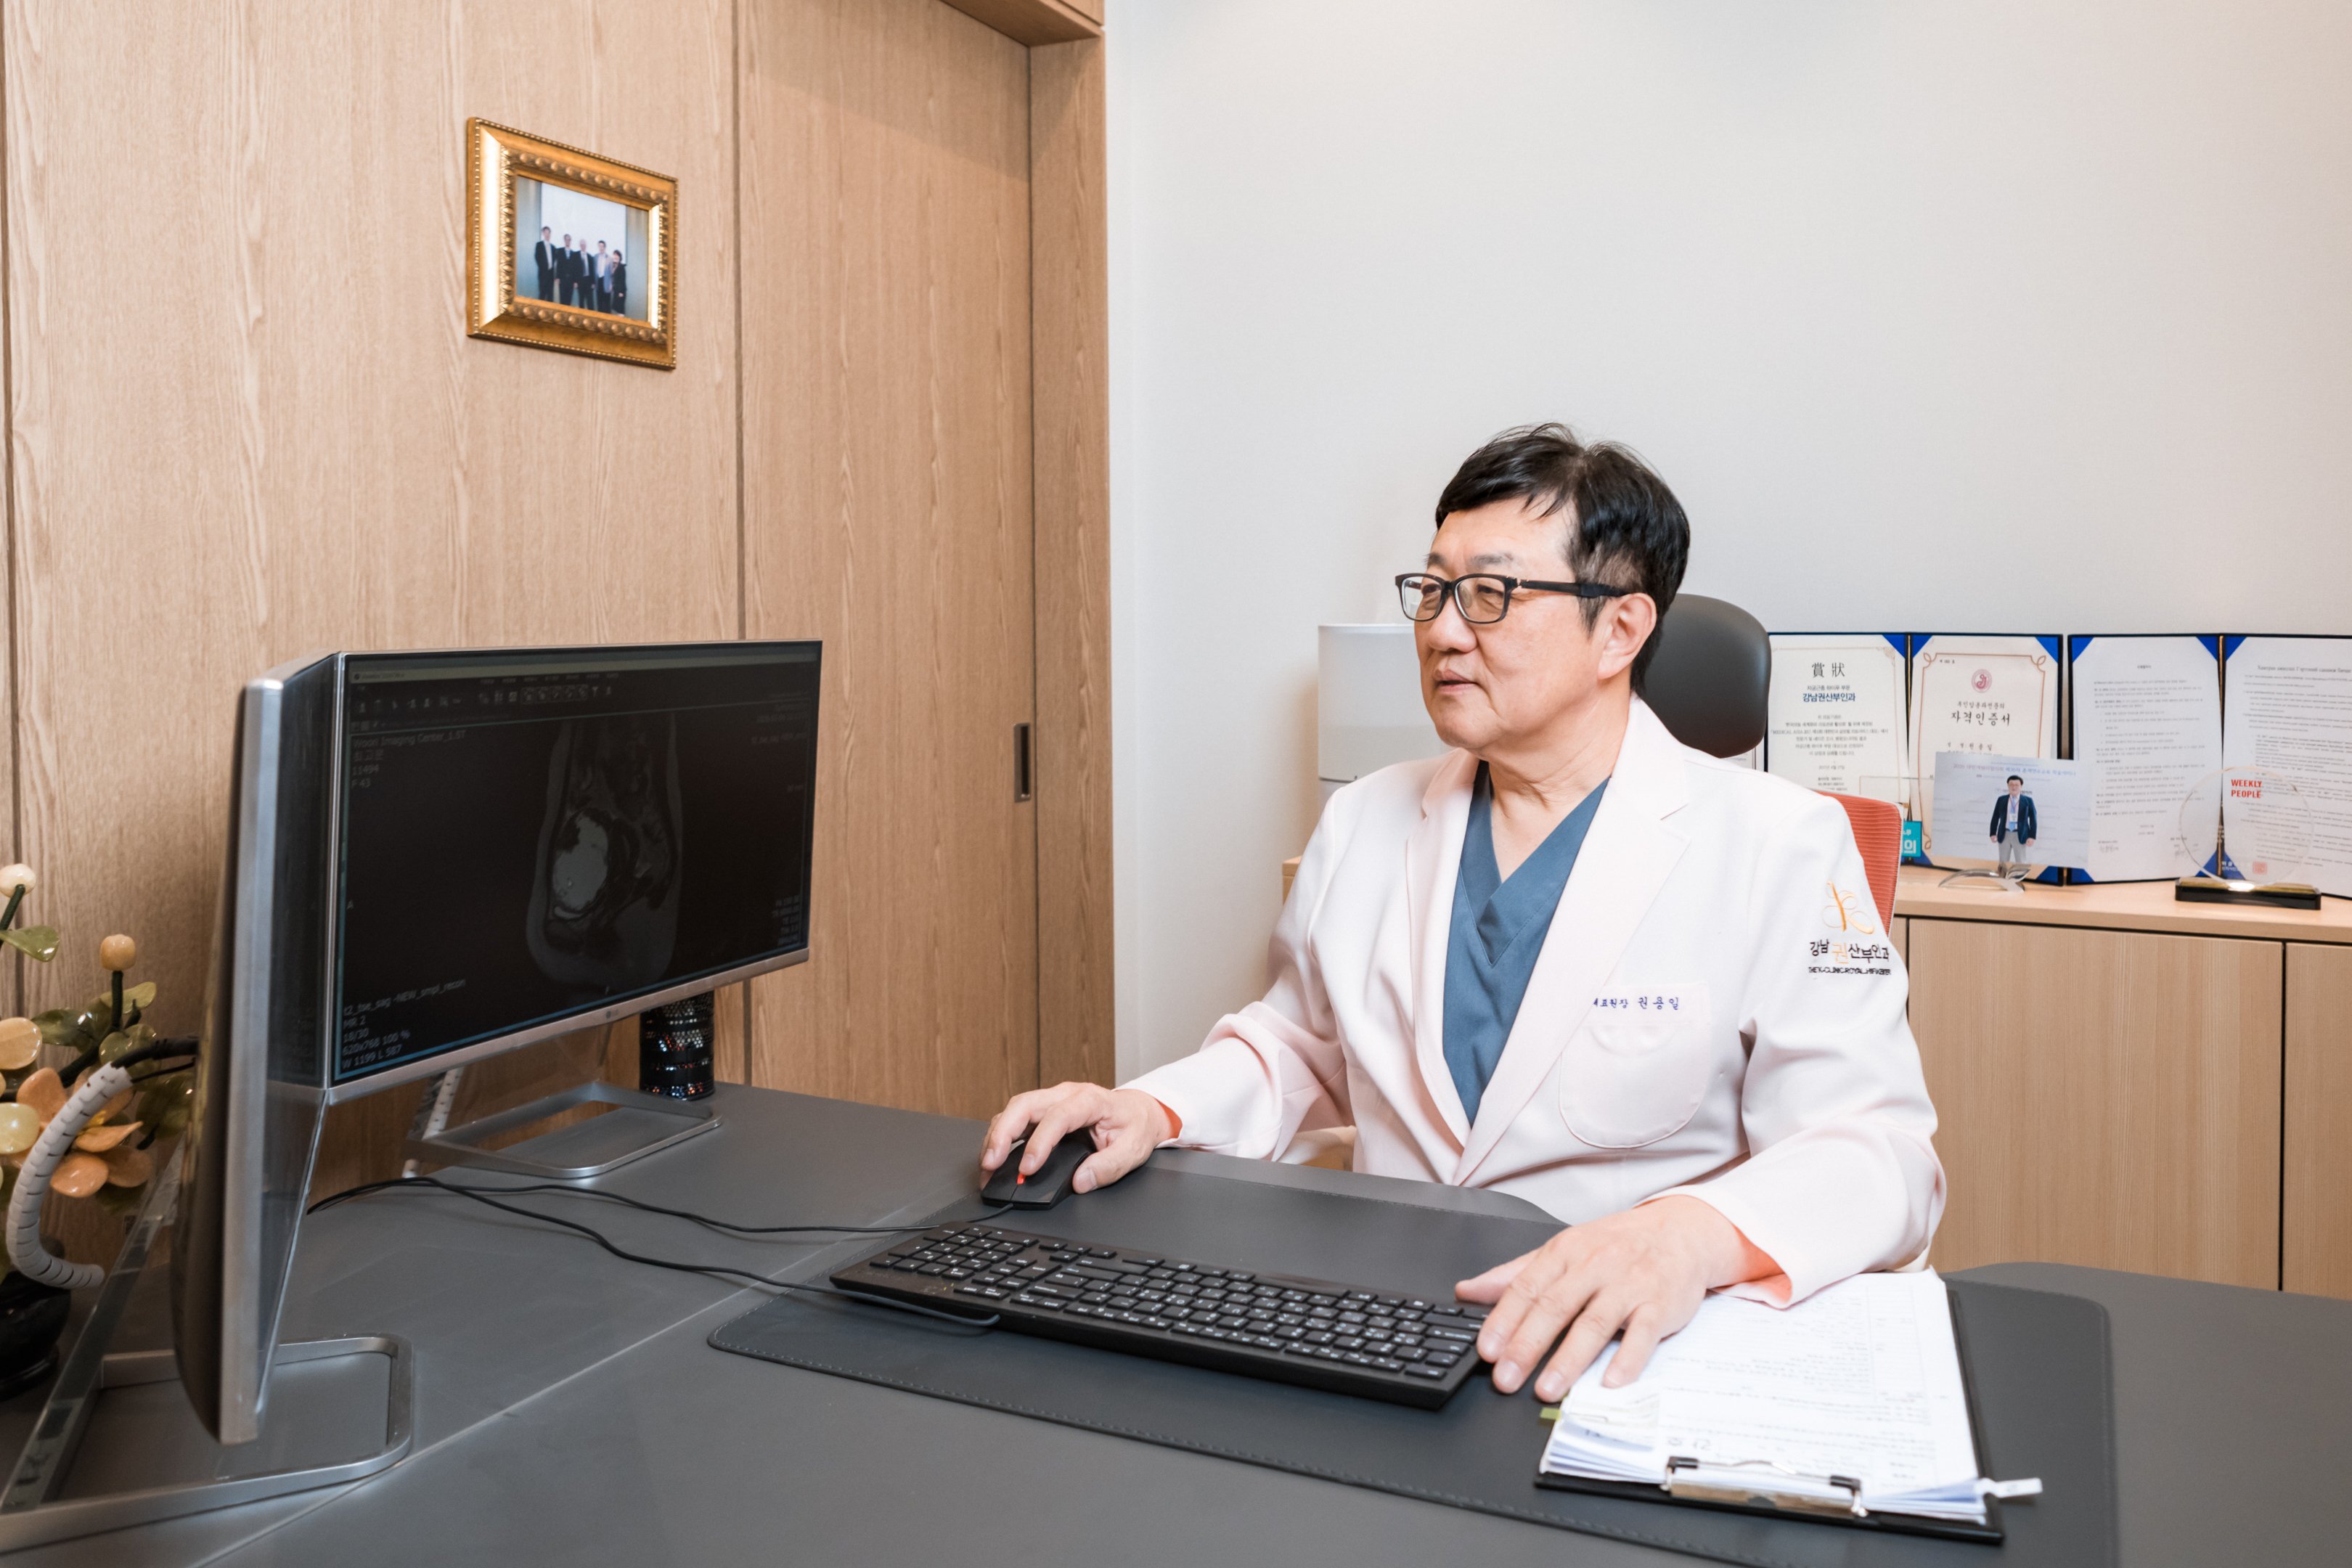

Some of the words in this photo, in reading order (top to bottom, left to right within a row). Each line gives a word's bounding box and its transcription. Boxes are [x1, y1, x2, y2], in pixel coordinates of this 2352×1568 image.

[1812, 662, 1845, 678] 賞狀
[1802, 693, 1855, 703] 강남권산부인과
[1951, 710, 2010, 727] 자격인증서
[2231, 779, 2262, 788] WEEKLY
[2231, 789, 2261, 799] PEOPLE
[360, 1016, 366, 1026] 2
[383, 1032, 399, 1045] 100
[400, 1029, 410, 1040] %
